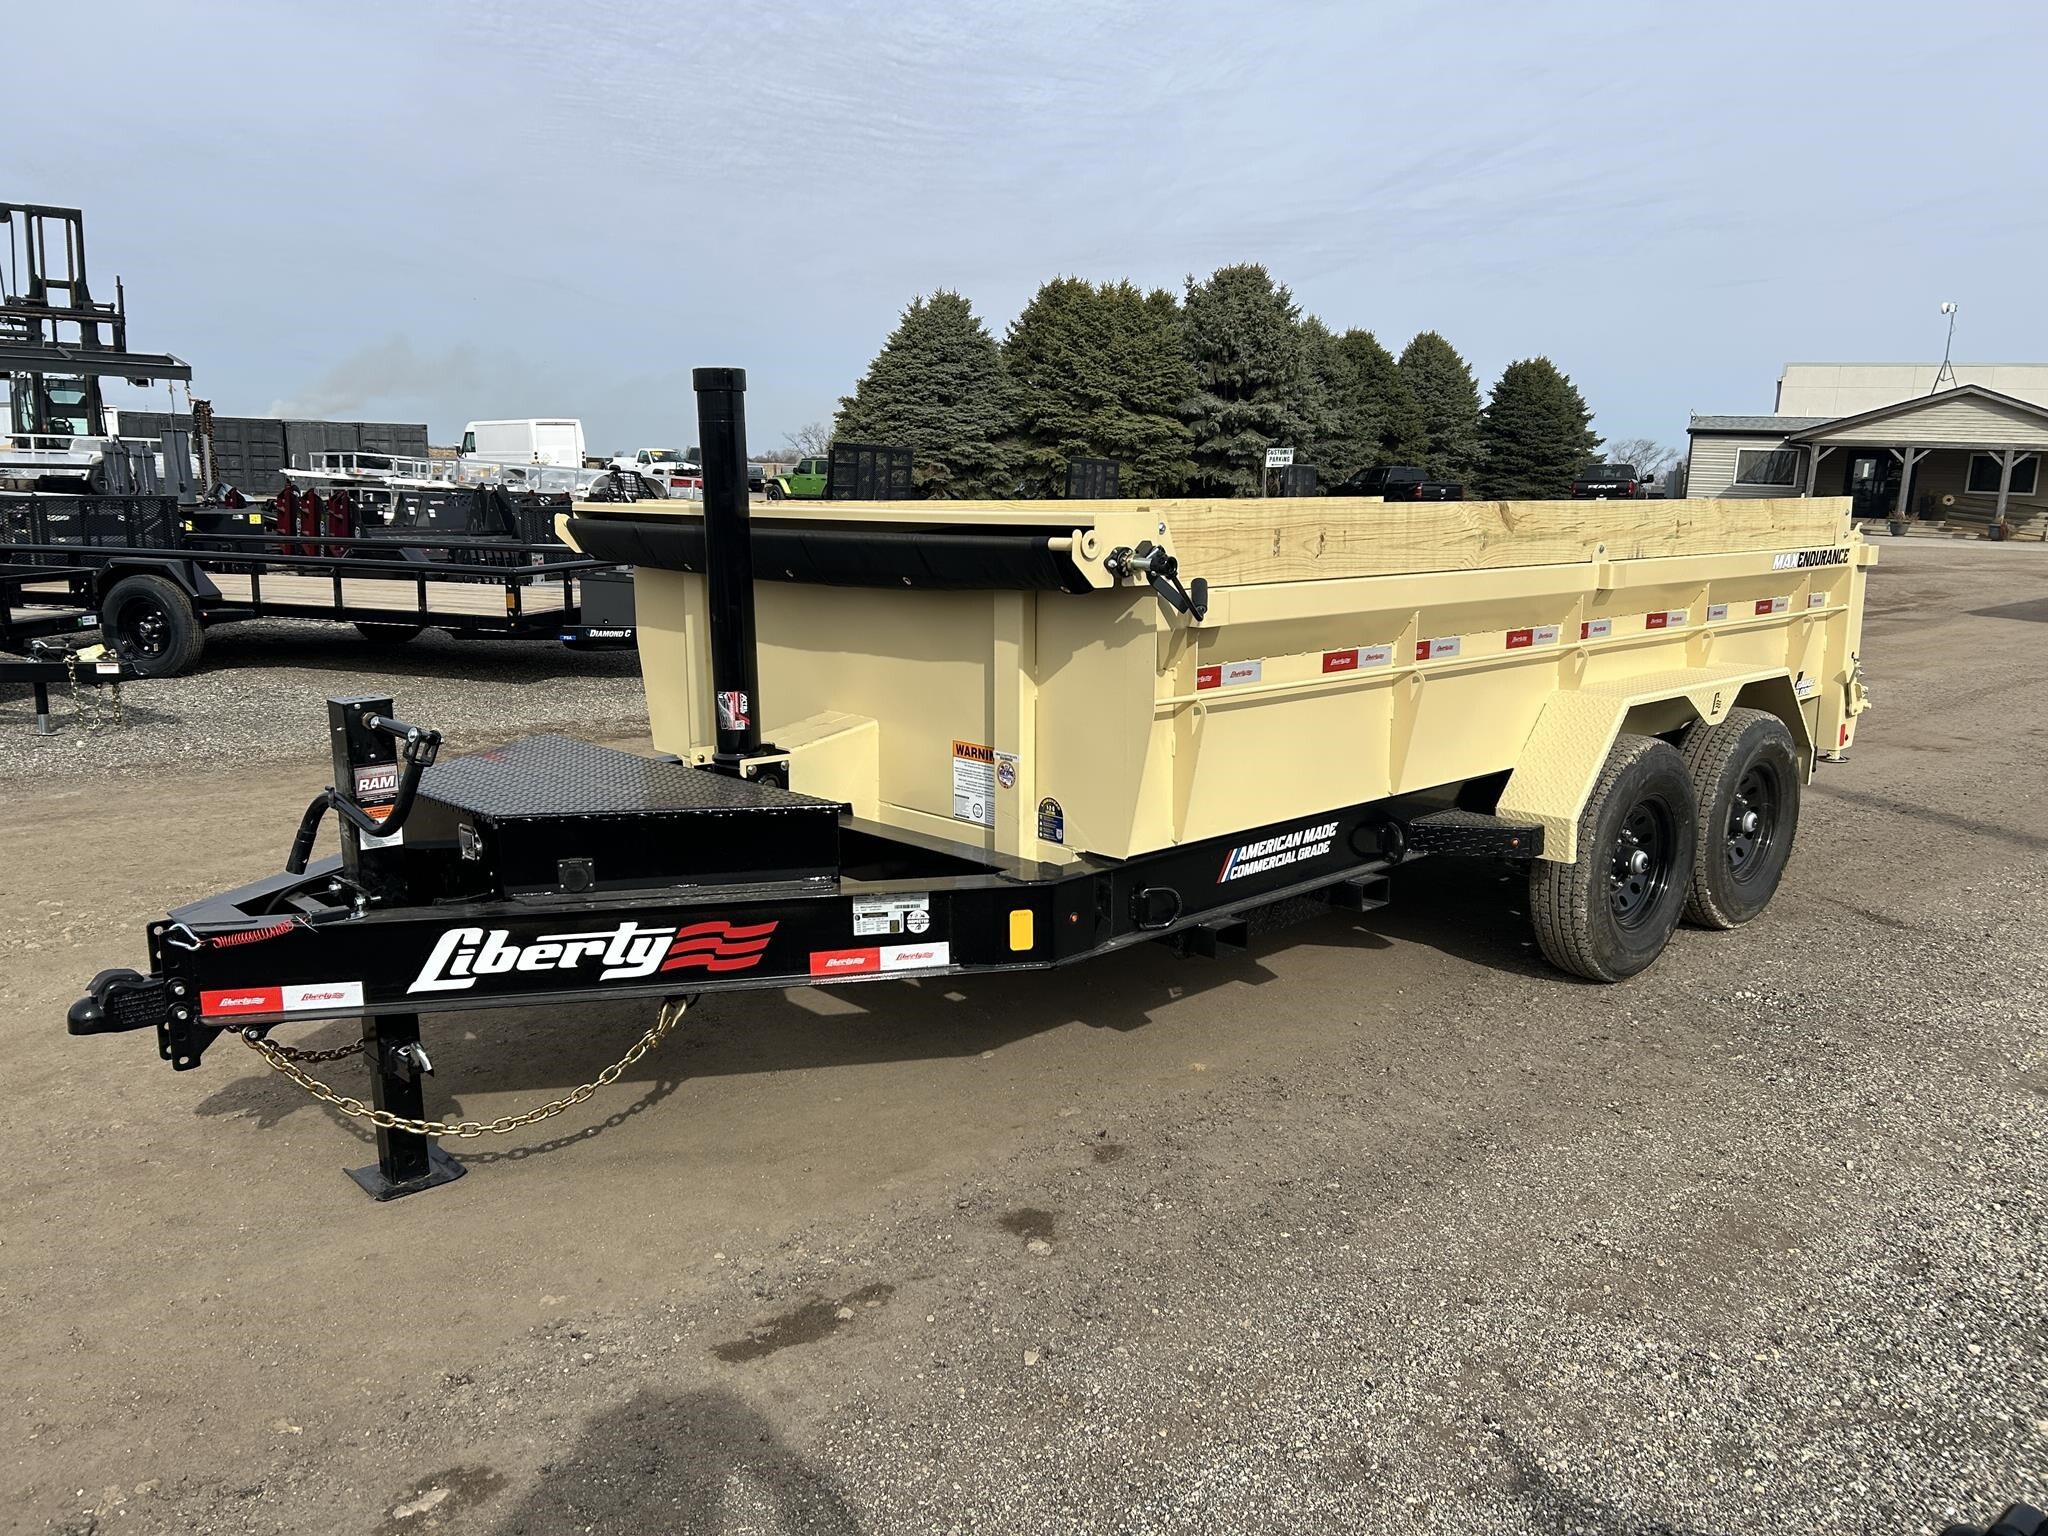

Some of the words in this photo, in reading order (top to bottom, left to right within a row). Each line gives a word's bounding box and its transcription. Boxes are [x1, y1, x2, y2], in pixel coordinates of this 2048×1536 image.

[589, 629, 624, 638] DIAMOND
[624, 629, 632, 638] C
[955, 743, 994, 762] WARNIN
[358, 775, 395, 791] RAM
[1236, 831, 1303, 863] AMERICAN
[1302, 822, 1340, 844] MADE
[1230, 850, 1297, 880] COMMERCIAL
[1297, 841, 1331, 861] GRADE
[406, 921, 677, 994] Liberty
[895, 952, 923, 961] Liberty
[301, 992, 333, 1001] Liberty
